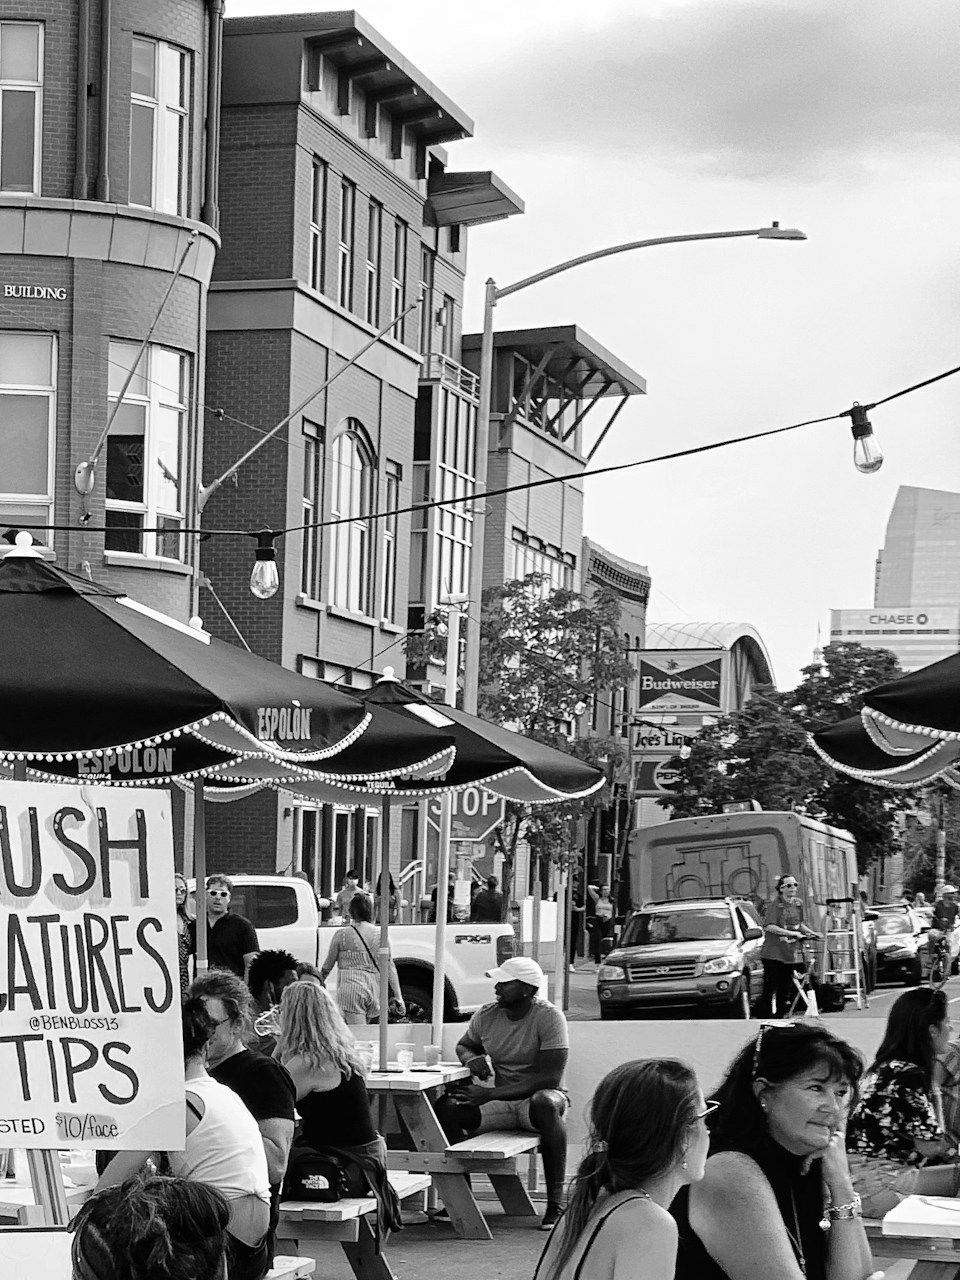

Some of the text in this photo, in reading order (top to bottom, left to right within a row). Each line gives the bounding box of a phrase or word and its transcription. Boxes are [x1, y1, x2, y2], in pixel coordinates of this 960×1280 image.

[4, 285, 67, 300] BUILDING
[869, 615, 914, 624] CHASE
[642, 676, 718, 690] Budweiser
[635, 732, 660, 747] Joe's
[366, 781, 396, 789] TEQUILA
[29, 1015, 119, 1031] @BENBLOSS13
[55, 1112, 120, 1141] $10/face
